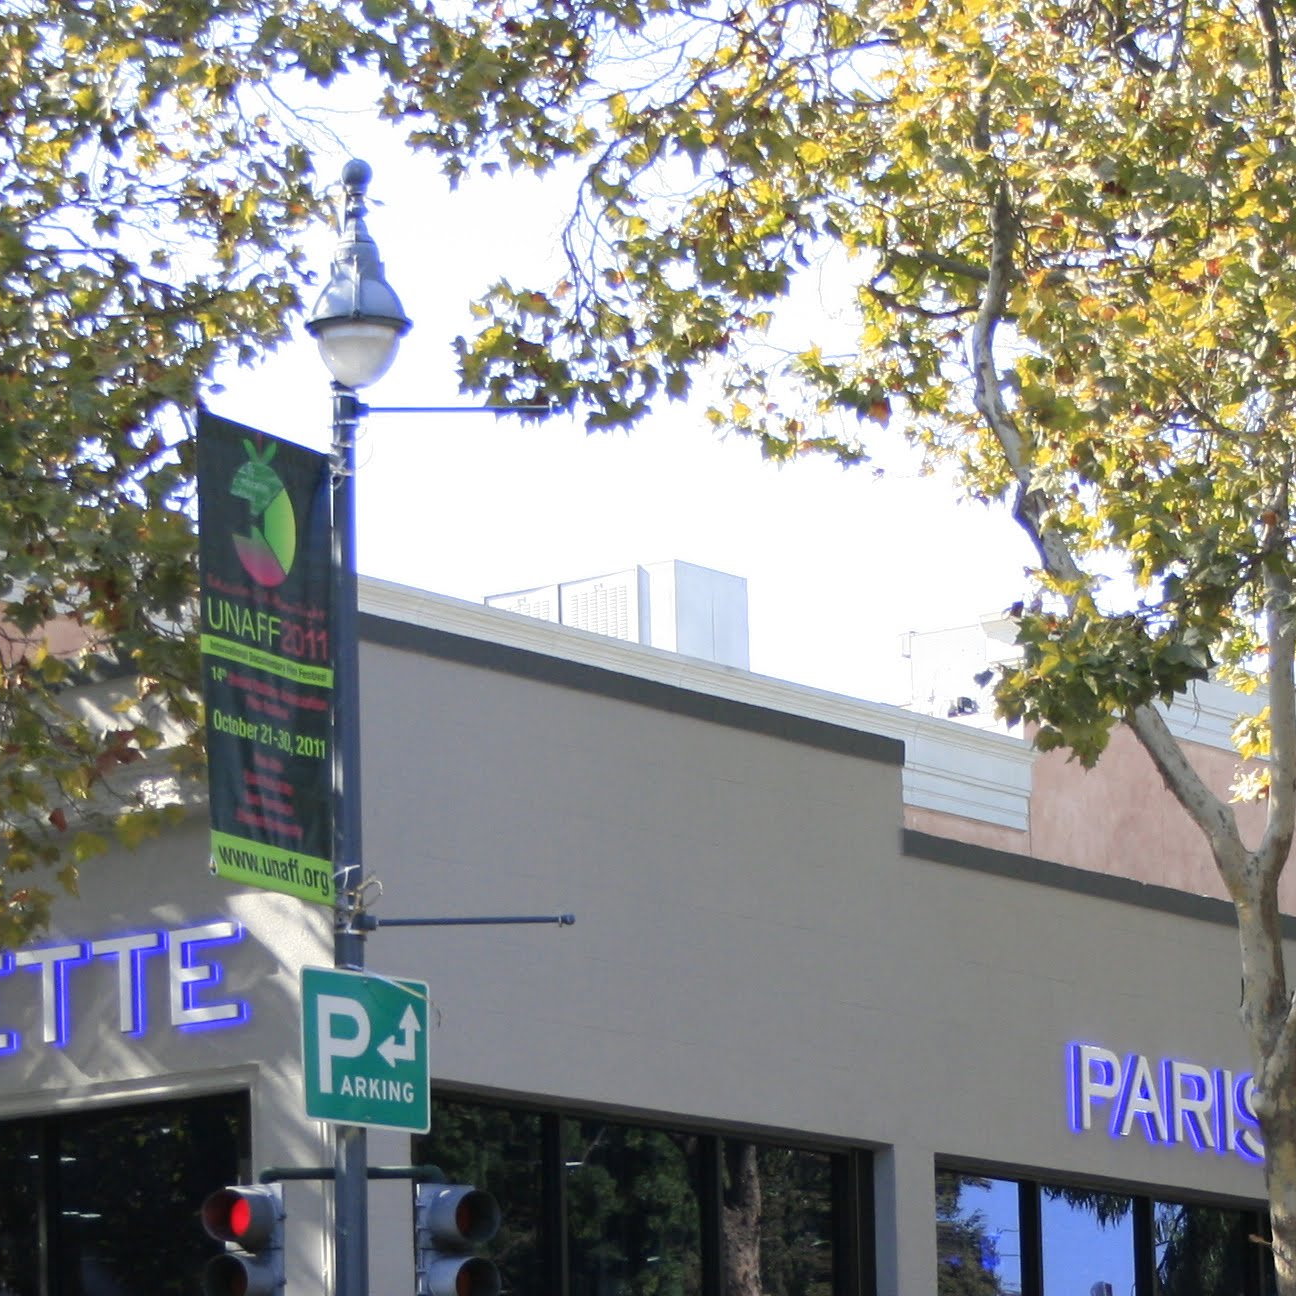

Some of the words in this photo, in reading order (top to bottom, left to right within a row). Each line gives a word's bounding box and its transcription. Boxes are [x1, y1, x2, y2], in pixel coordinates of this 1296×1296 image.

[213, 709, 258, 741] October
[261, 724, 293, 757] 21-30,
[296, 735, 326, 760] 2011
[218, 844, 330, 897] www.unaff.org
